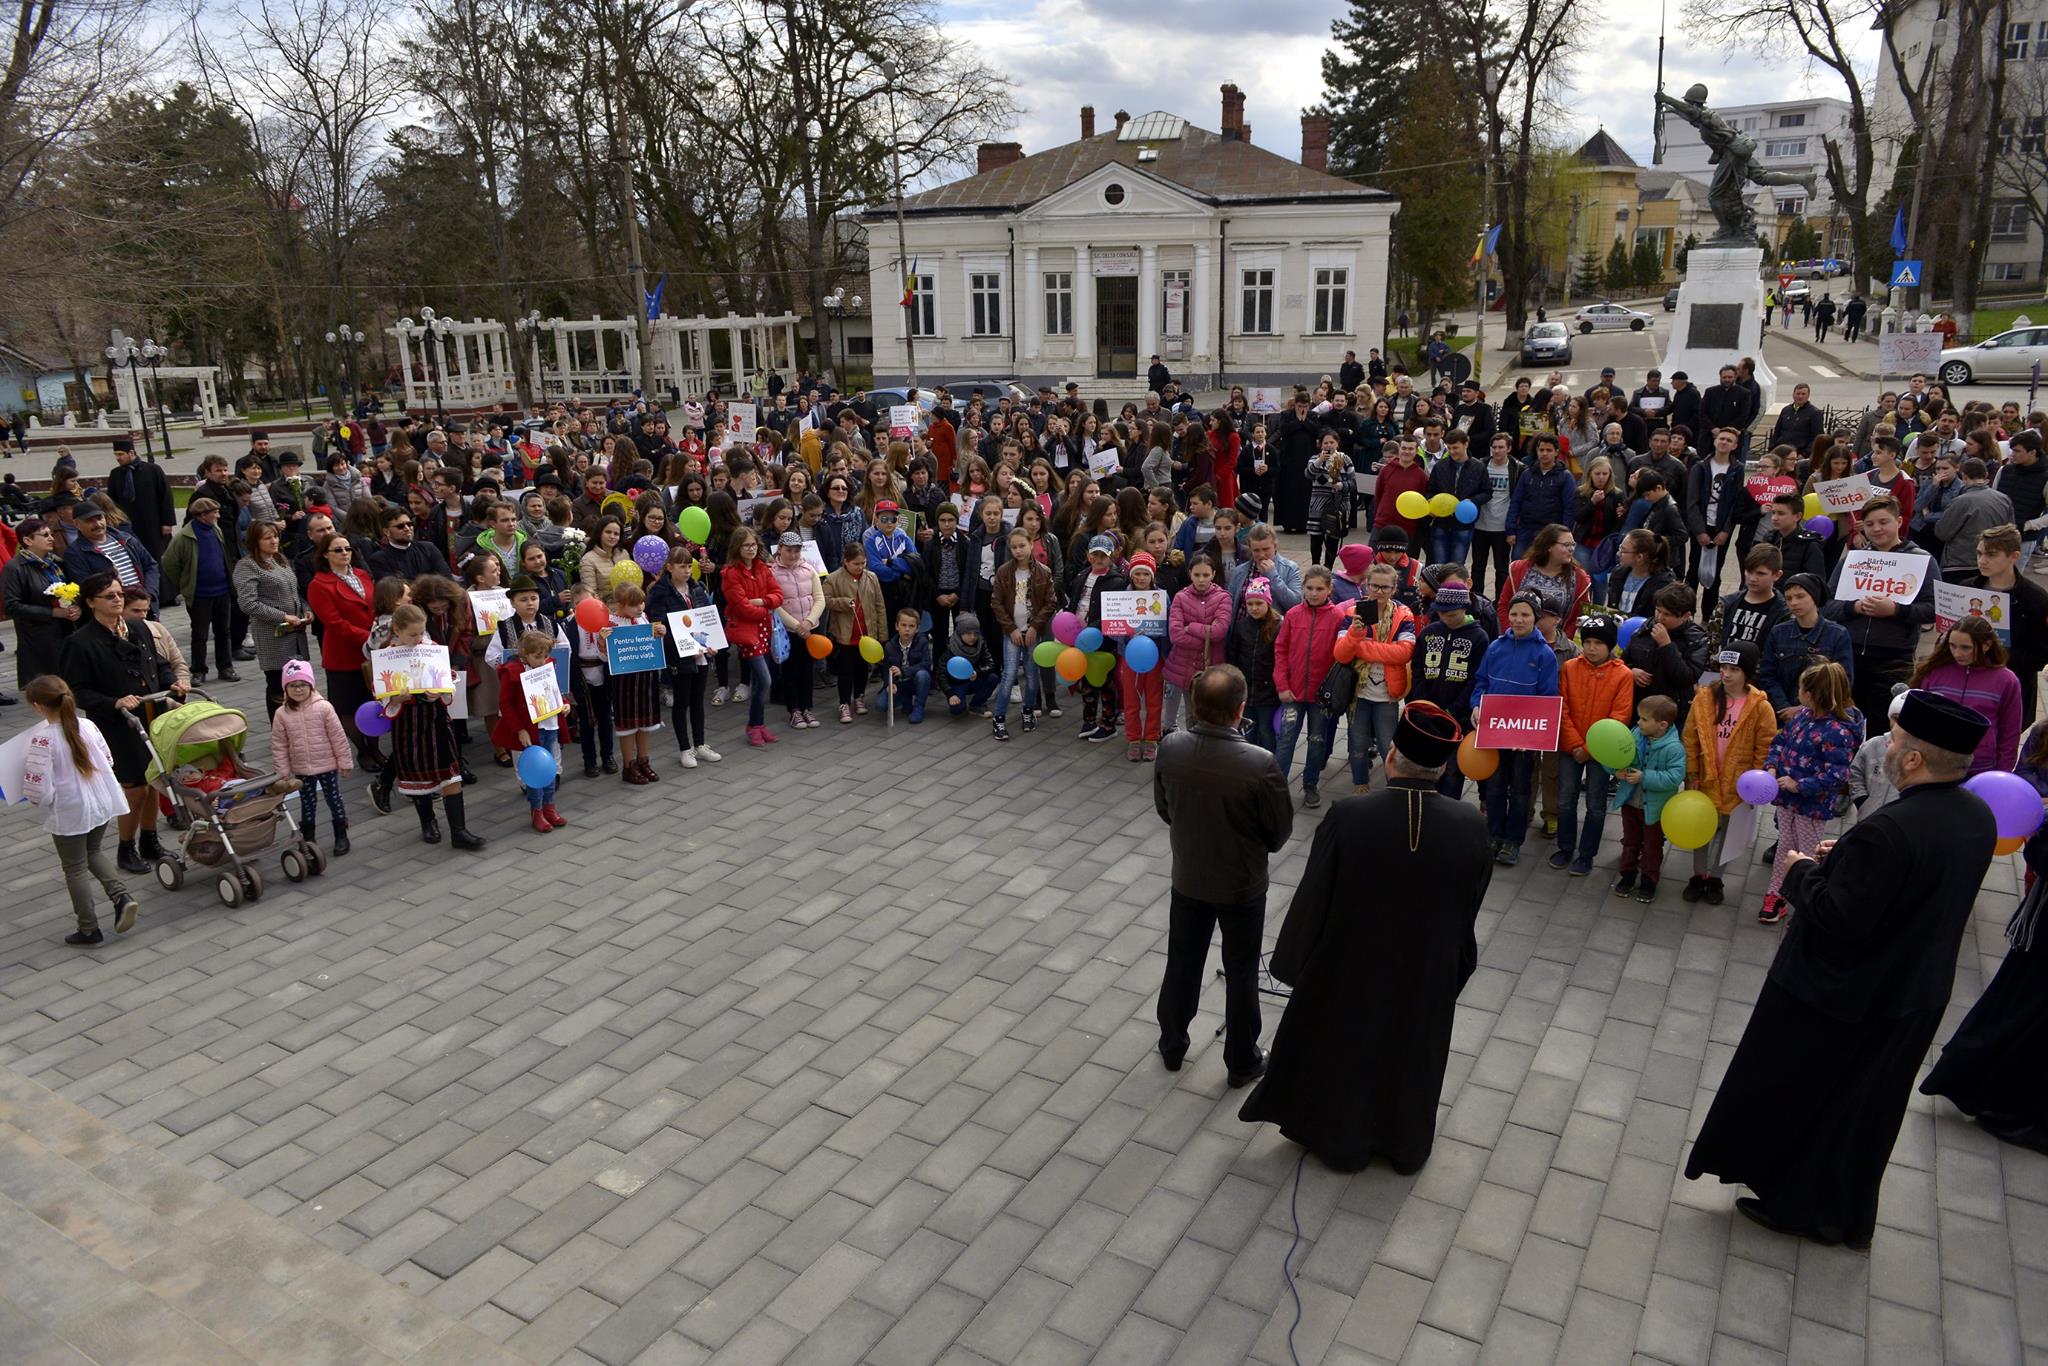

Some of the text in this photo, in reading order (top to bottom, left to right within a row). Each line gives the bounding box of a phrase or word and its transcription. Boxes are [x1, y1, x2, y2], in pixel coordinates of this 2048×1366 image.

[1855, 574, 1906, 597] viața
[618, 646, 638, 654] pentru
[619, 654, 639, 663] pentru
[1489, 717, 1548, 730] FAMILIE
